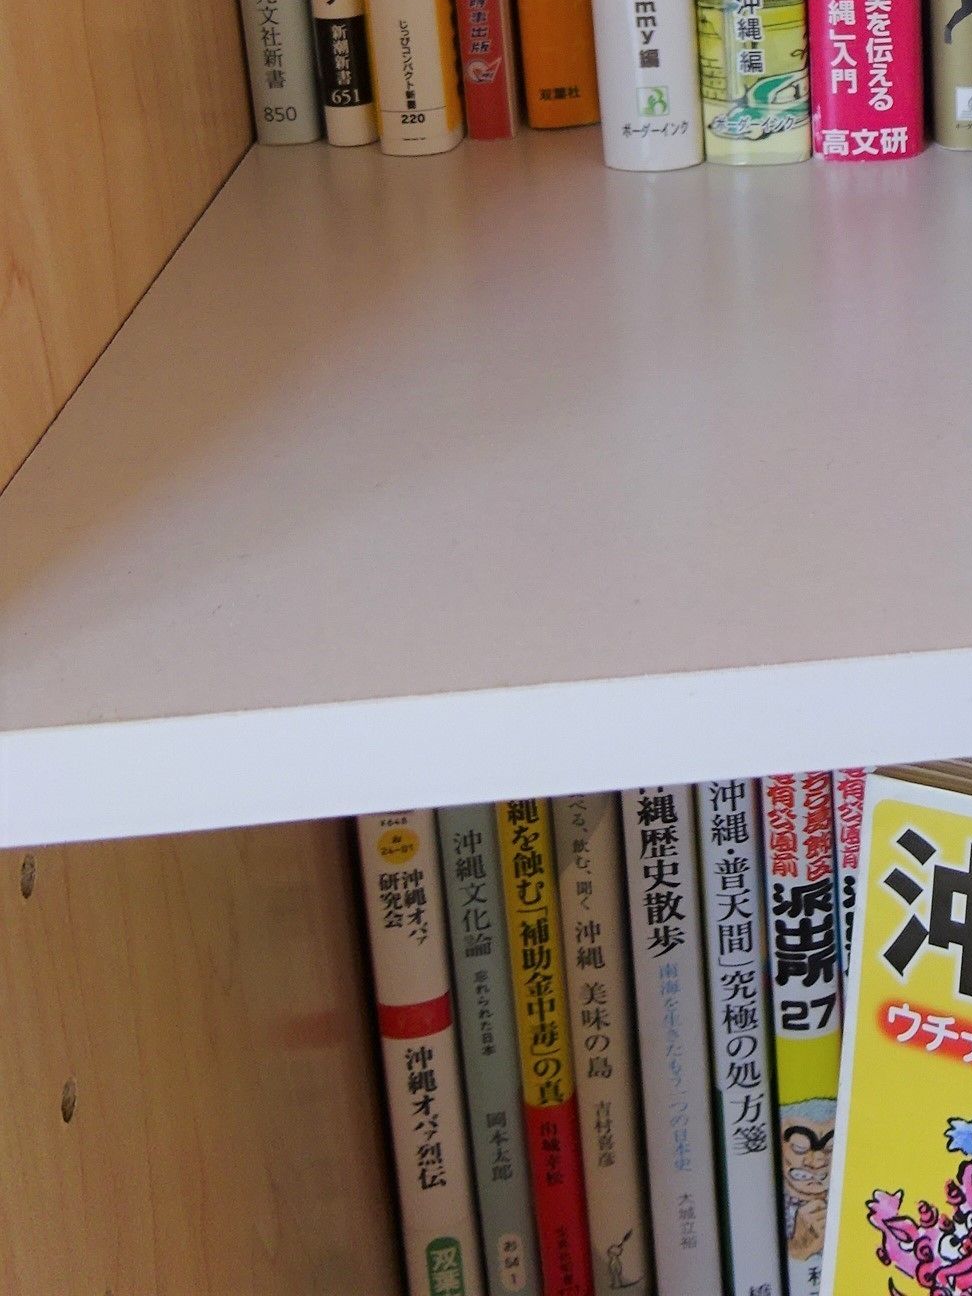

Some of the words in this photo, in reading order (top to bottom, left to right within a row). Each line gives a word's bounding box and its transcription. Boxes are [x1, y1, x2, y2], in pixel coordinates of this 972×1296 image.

[738, 48, 764, 75] 編
[263, 106, 299, 124] 850
[331, 88, 361, 105] 651
[401, 114, 425, 124] 220
[821, 128, 909, 155] 高文研
[378, 871, 403, 929] 研究会
[453, 830, 493, 959] 沖縄文化論
[637, 787, 686, 960] 縄歴史散歩
[576, 919, 606, 968] 沖縄
[773, 877, 837, 987] 派出所
[583, 982, 614, 1080] 美味の島
[781, 992, 837, 1031] 27
[404, 1047, 448, 1191] 沖縄オバァ烈伝
[486, 1111, 514, 1182] 岡本太郎
